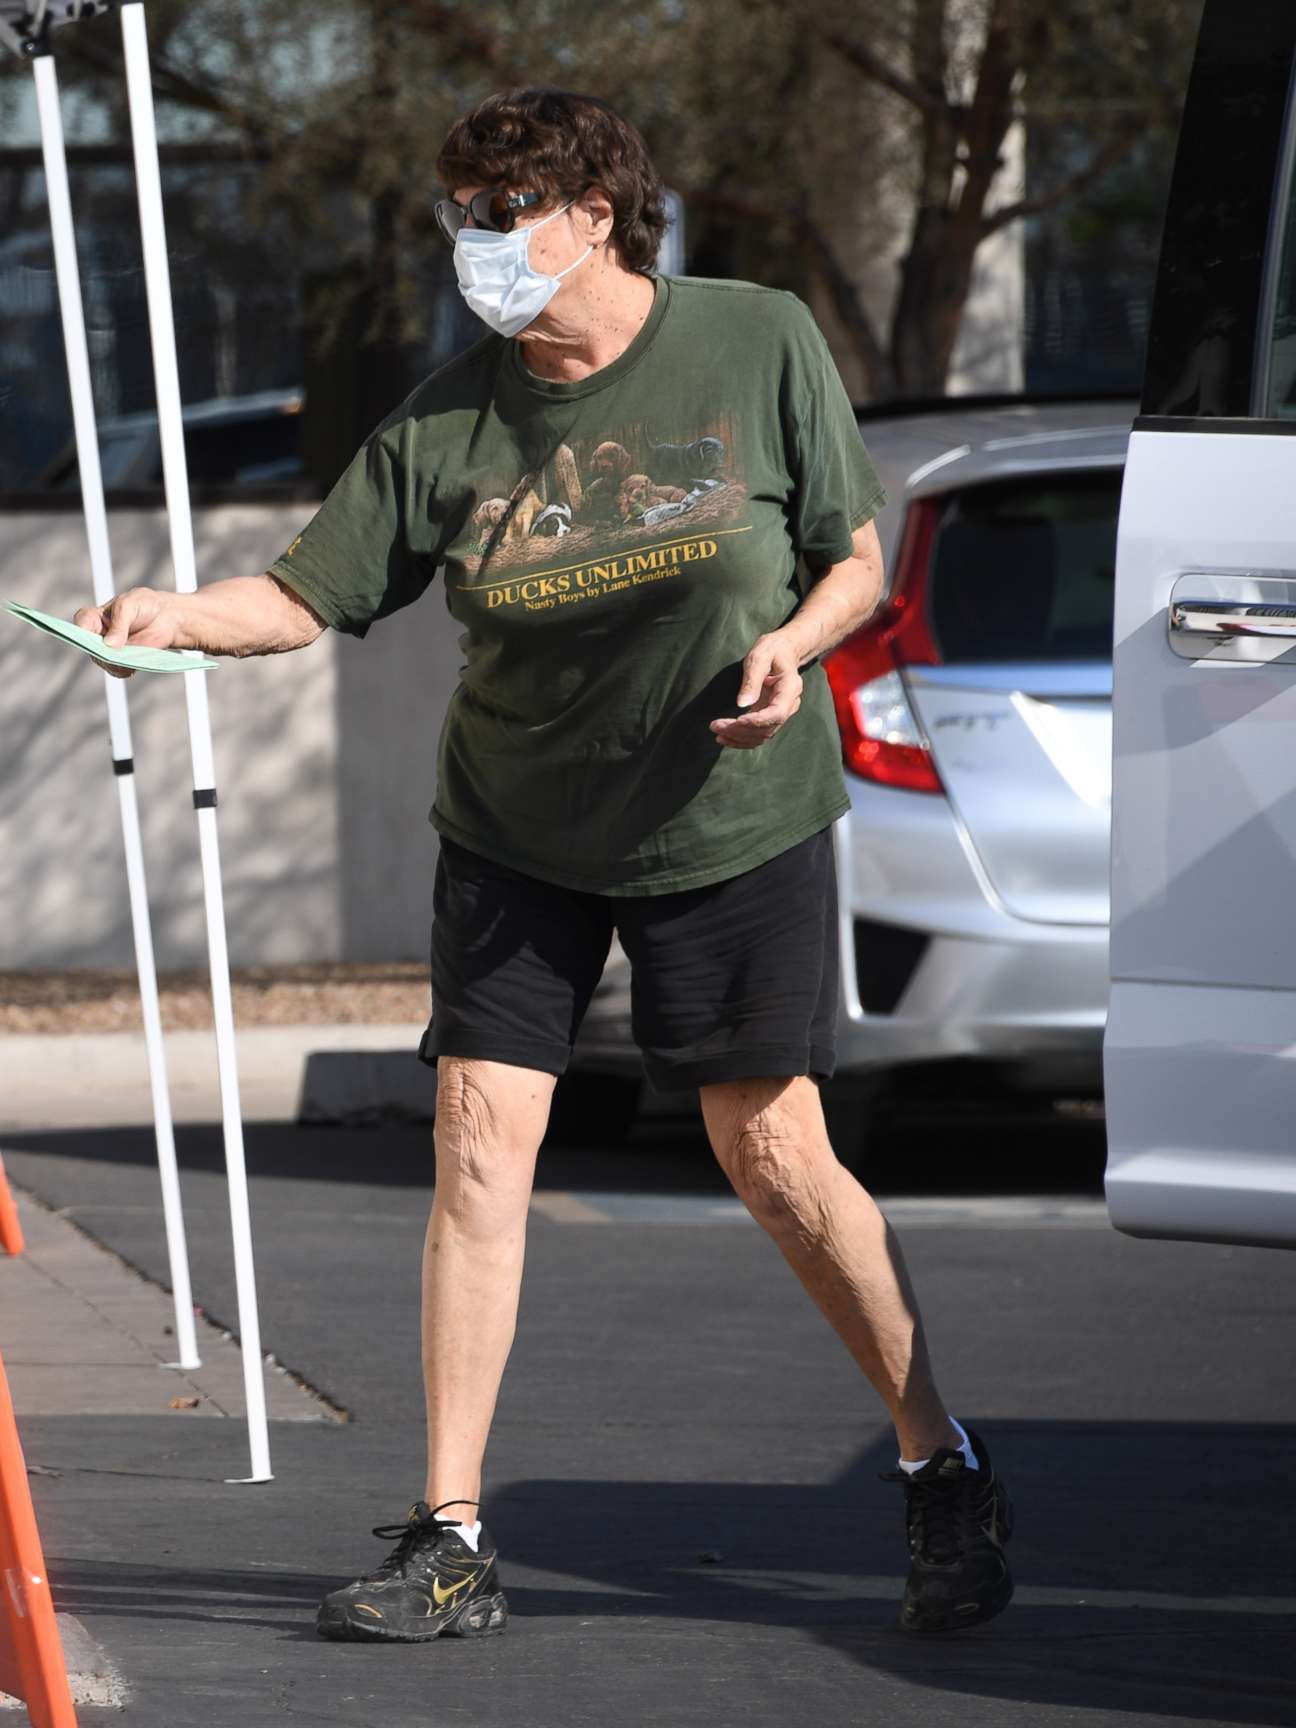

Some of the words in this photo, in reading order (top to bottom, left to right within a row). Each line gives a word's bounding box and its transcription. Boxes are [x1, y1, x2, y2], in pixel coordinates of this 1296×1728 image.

[487, 574, 571, 608] DUCKS
[575, 540, 718, 588] UNLIMITED
[558, 591, 586, 604] Boys
[586, 585, 600, 598] by
[603, 579, 630, 593] Lane
[632, 565, 681, 585] Kendrick
